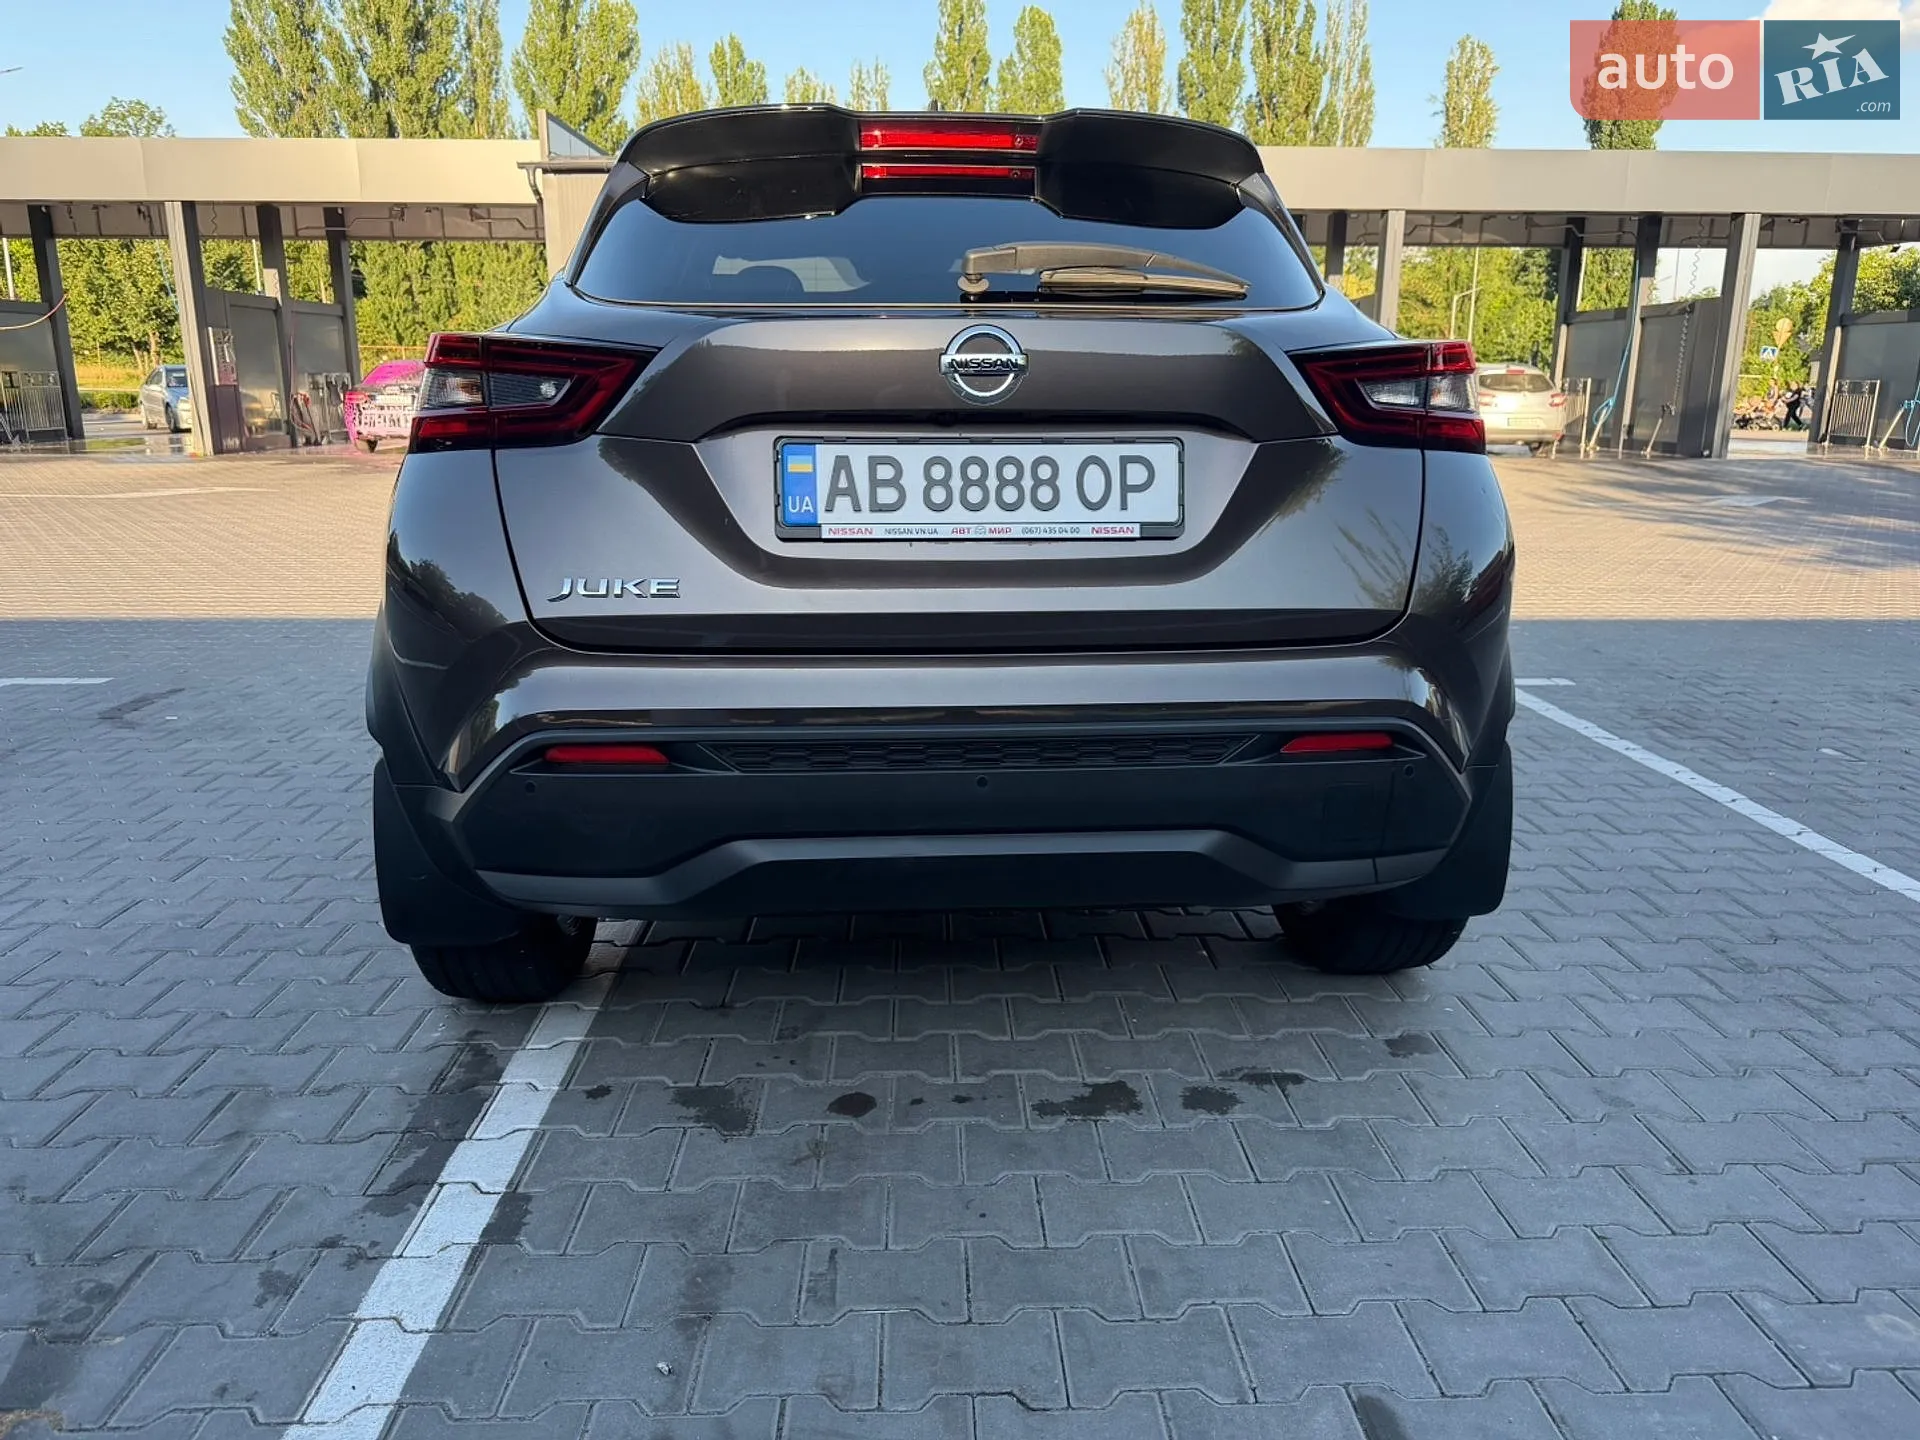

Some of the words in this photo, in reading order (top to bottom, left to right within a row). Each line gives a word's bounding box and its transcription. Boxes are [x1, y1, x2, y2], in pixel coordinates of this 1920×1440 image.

[950, 358, 1019, 369] NISSAN
[824, 454, 907, 512] AB
[922, 455, 1061, 512] 8888
[1076, 454, 1156, 512] OP
[788, 495, 814, 514] UA
[828, 527, 874, 536] NISSAN
[1021, 526, 1041, 536] (067)
[1091, 526, 1135, 535] NISSAN
[546, 577, 681, 602] JUKE
